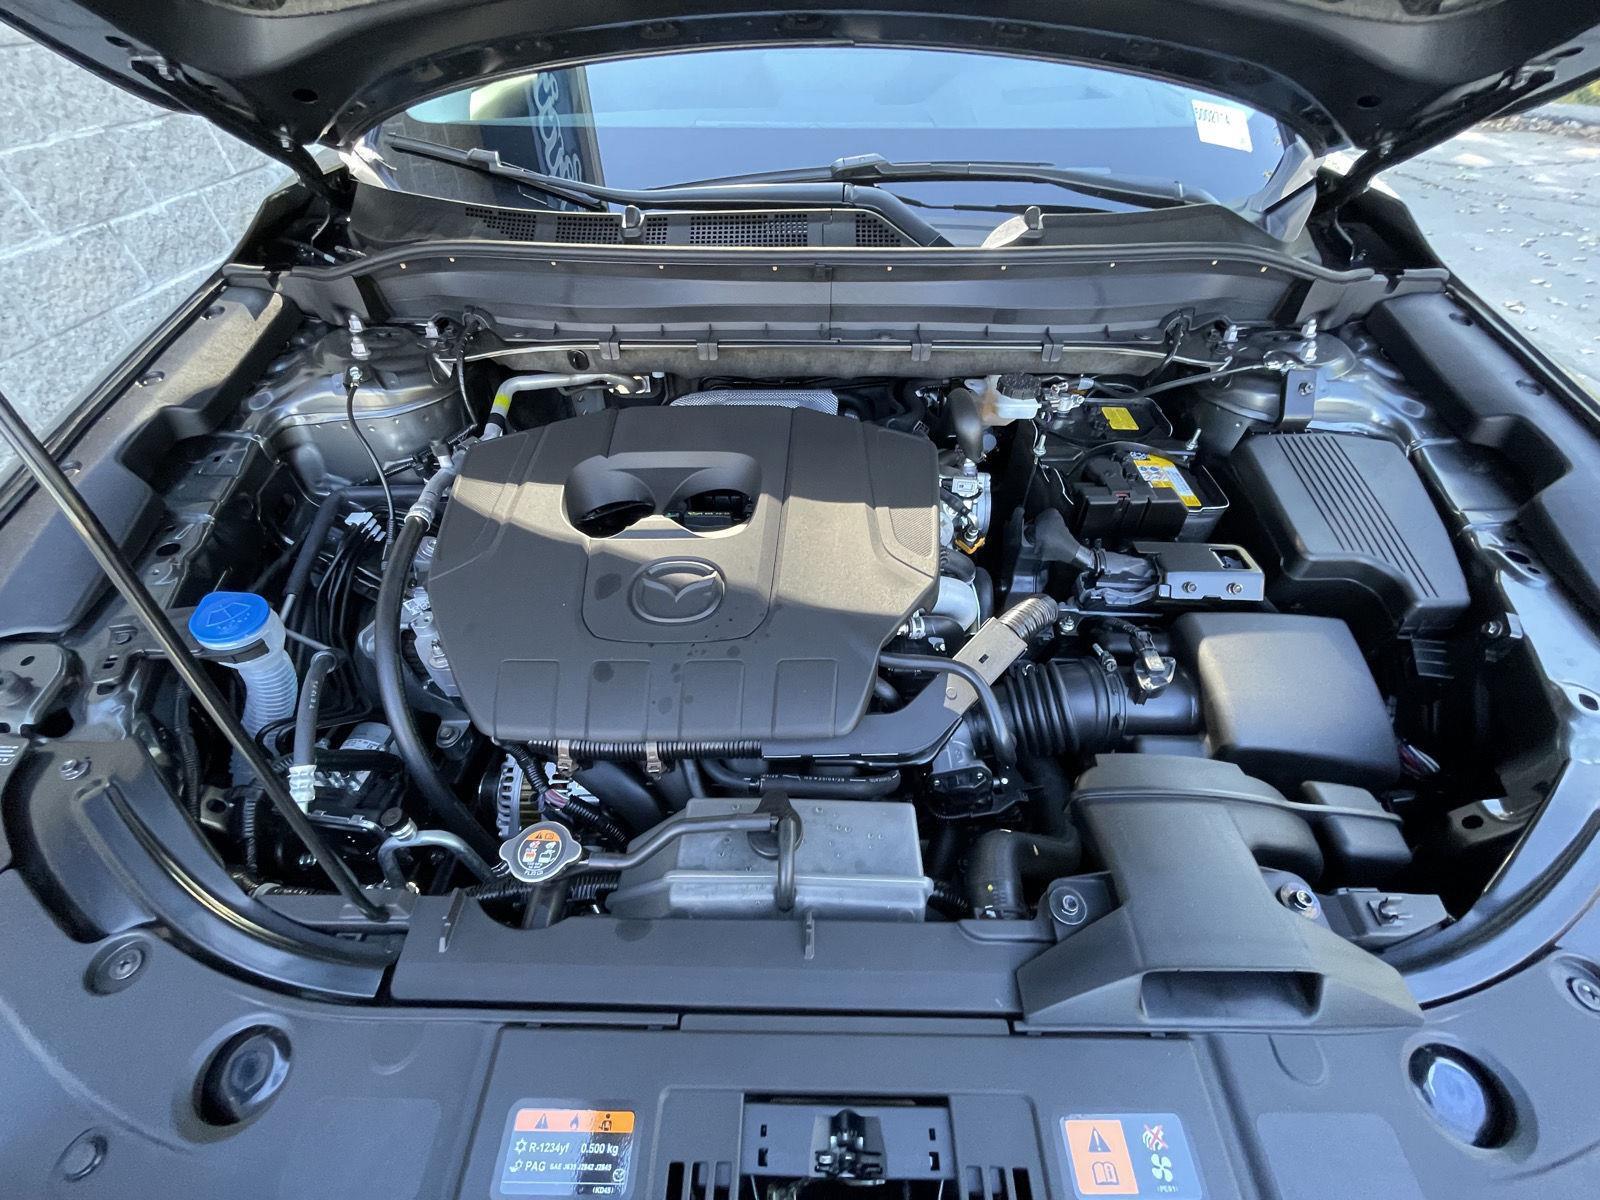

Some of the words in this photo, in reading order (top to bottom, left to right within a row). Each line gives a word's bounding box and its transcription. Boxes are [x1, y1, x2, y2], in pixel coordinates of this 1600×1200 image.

[528, 1141, 570, 1155] R-1234yf
[581, 1142, 605, 1154] 0.500
[607, 1143, 619, 1156] kg
[525, 1160, 546, 1172] PAG
